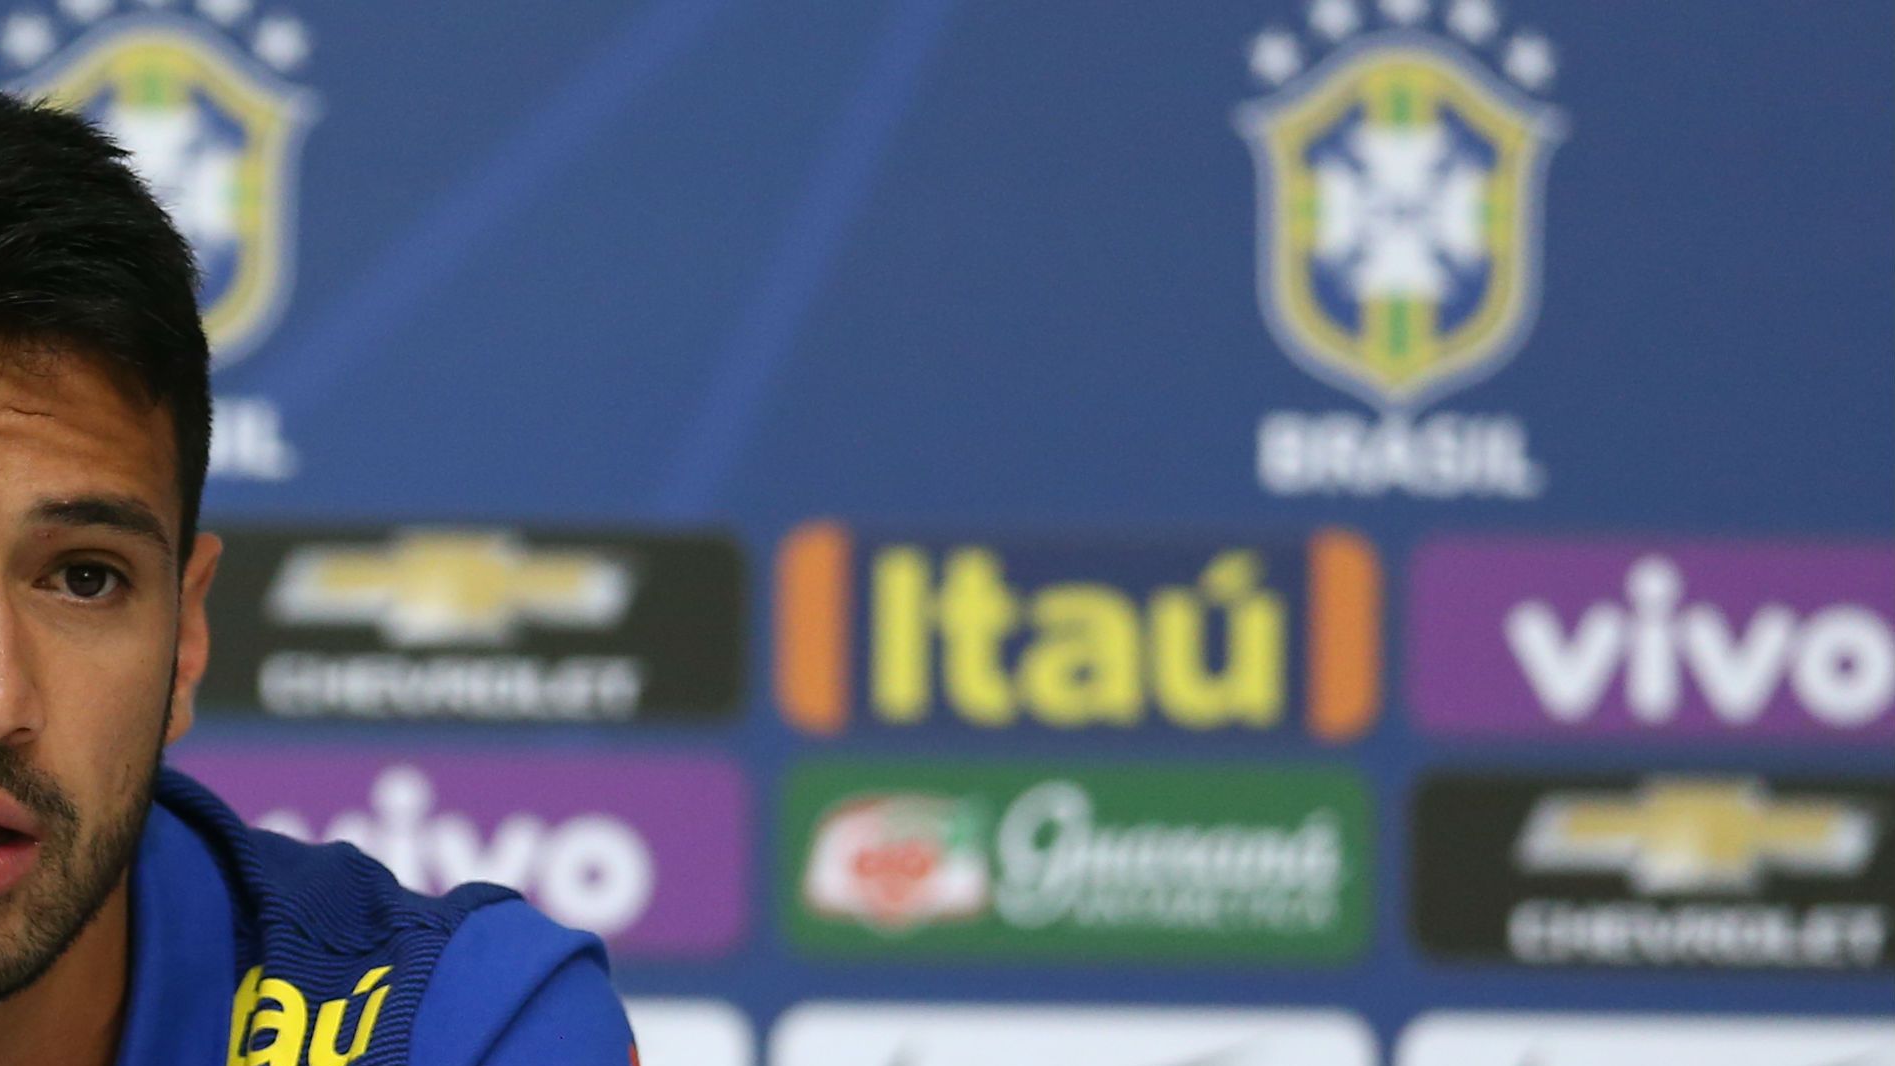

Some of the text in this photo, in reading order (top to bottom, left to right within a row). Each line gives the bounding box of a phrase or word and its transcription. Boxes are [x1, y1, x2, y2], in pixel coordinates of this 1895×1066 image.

[1257, 412, 1547, 498] BRASIL
[257, 652, 642, 720] CHEVROLET
[869, 544, 1287, 730] Itaú
[1507, 554, 1895, 728] vivo
[251, 764, 655, 938] ivo
[1508, 902, 1887, 968] CHEVROLET
